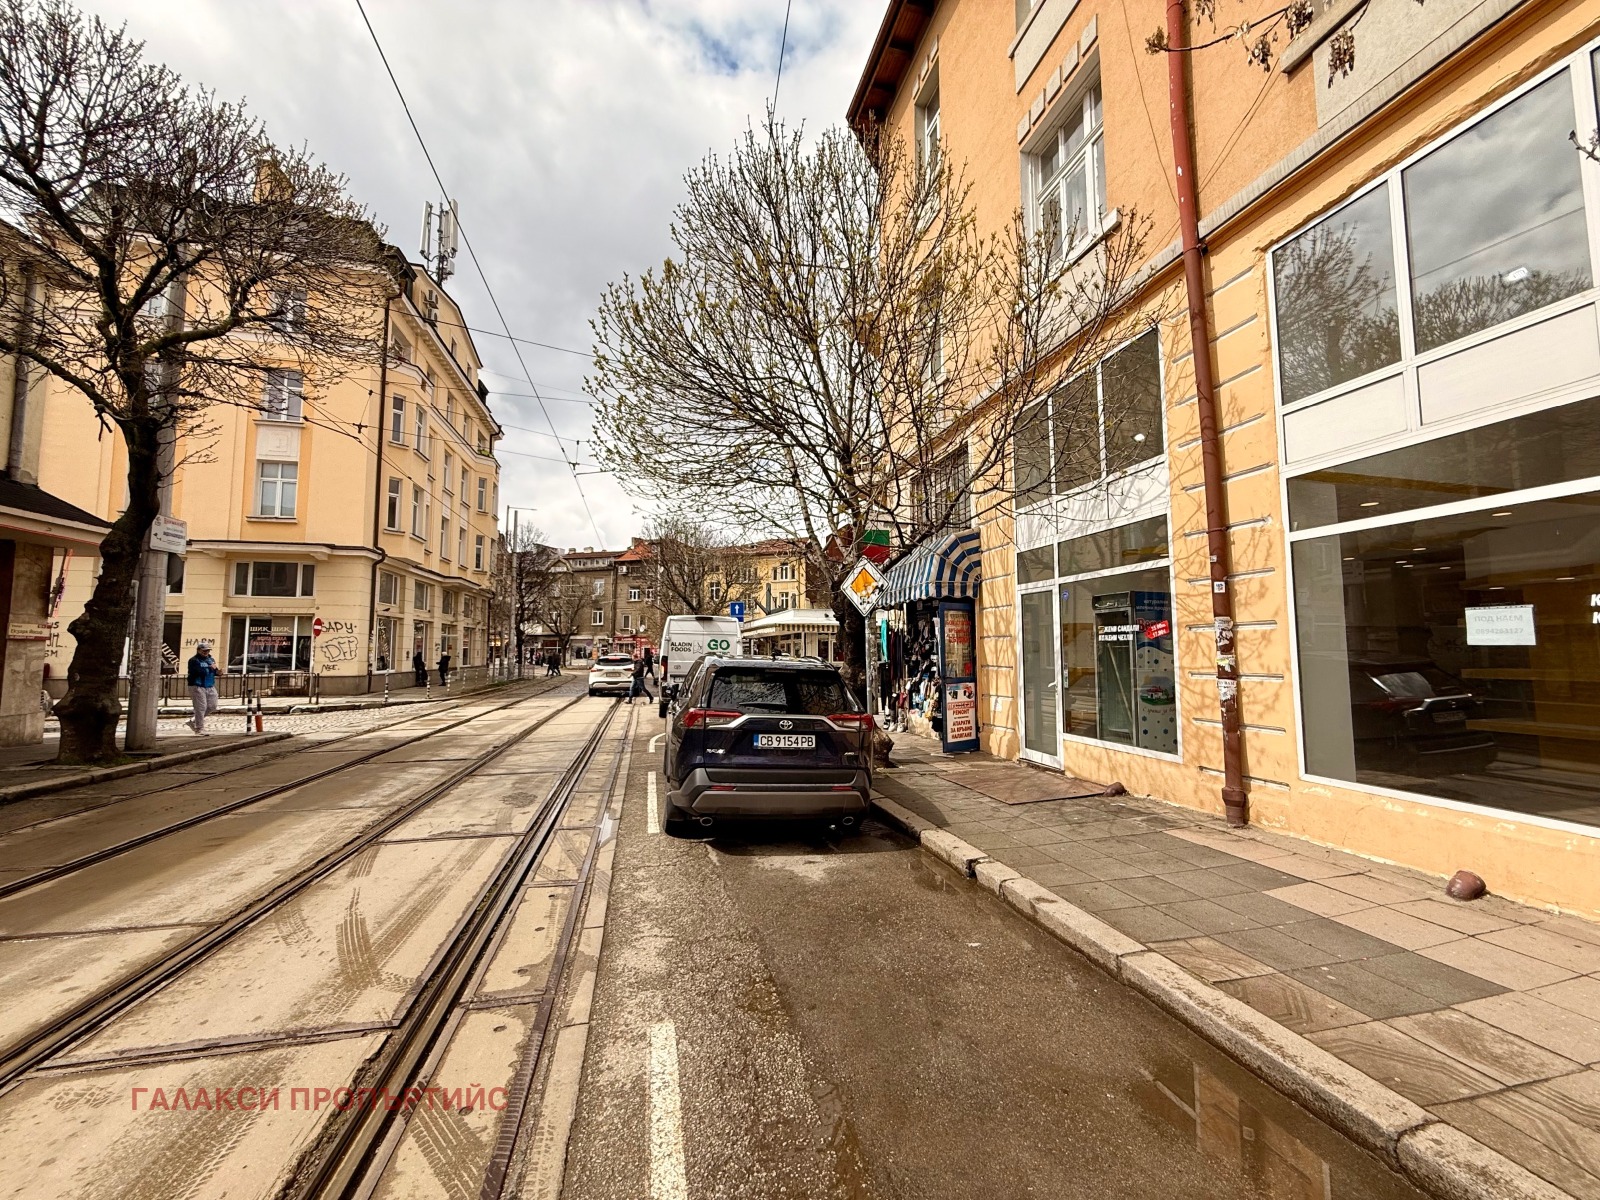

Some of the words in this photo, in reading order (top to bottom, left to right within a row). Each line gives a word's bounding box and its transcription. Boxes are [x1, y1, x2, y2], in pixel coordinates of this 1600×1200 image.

[1474, 615, 1494, 623] ПОД
[1496, 614, 1523, 622] НАЕМ
[707, 639, 730, 651] GO
[760, 736, 773, 746] CB
[775, 736, 799, 746] 9154
[801, 736, 814, 747] PB
